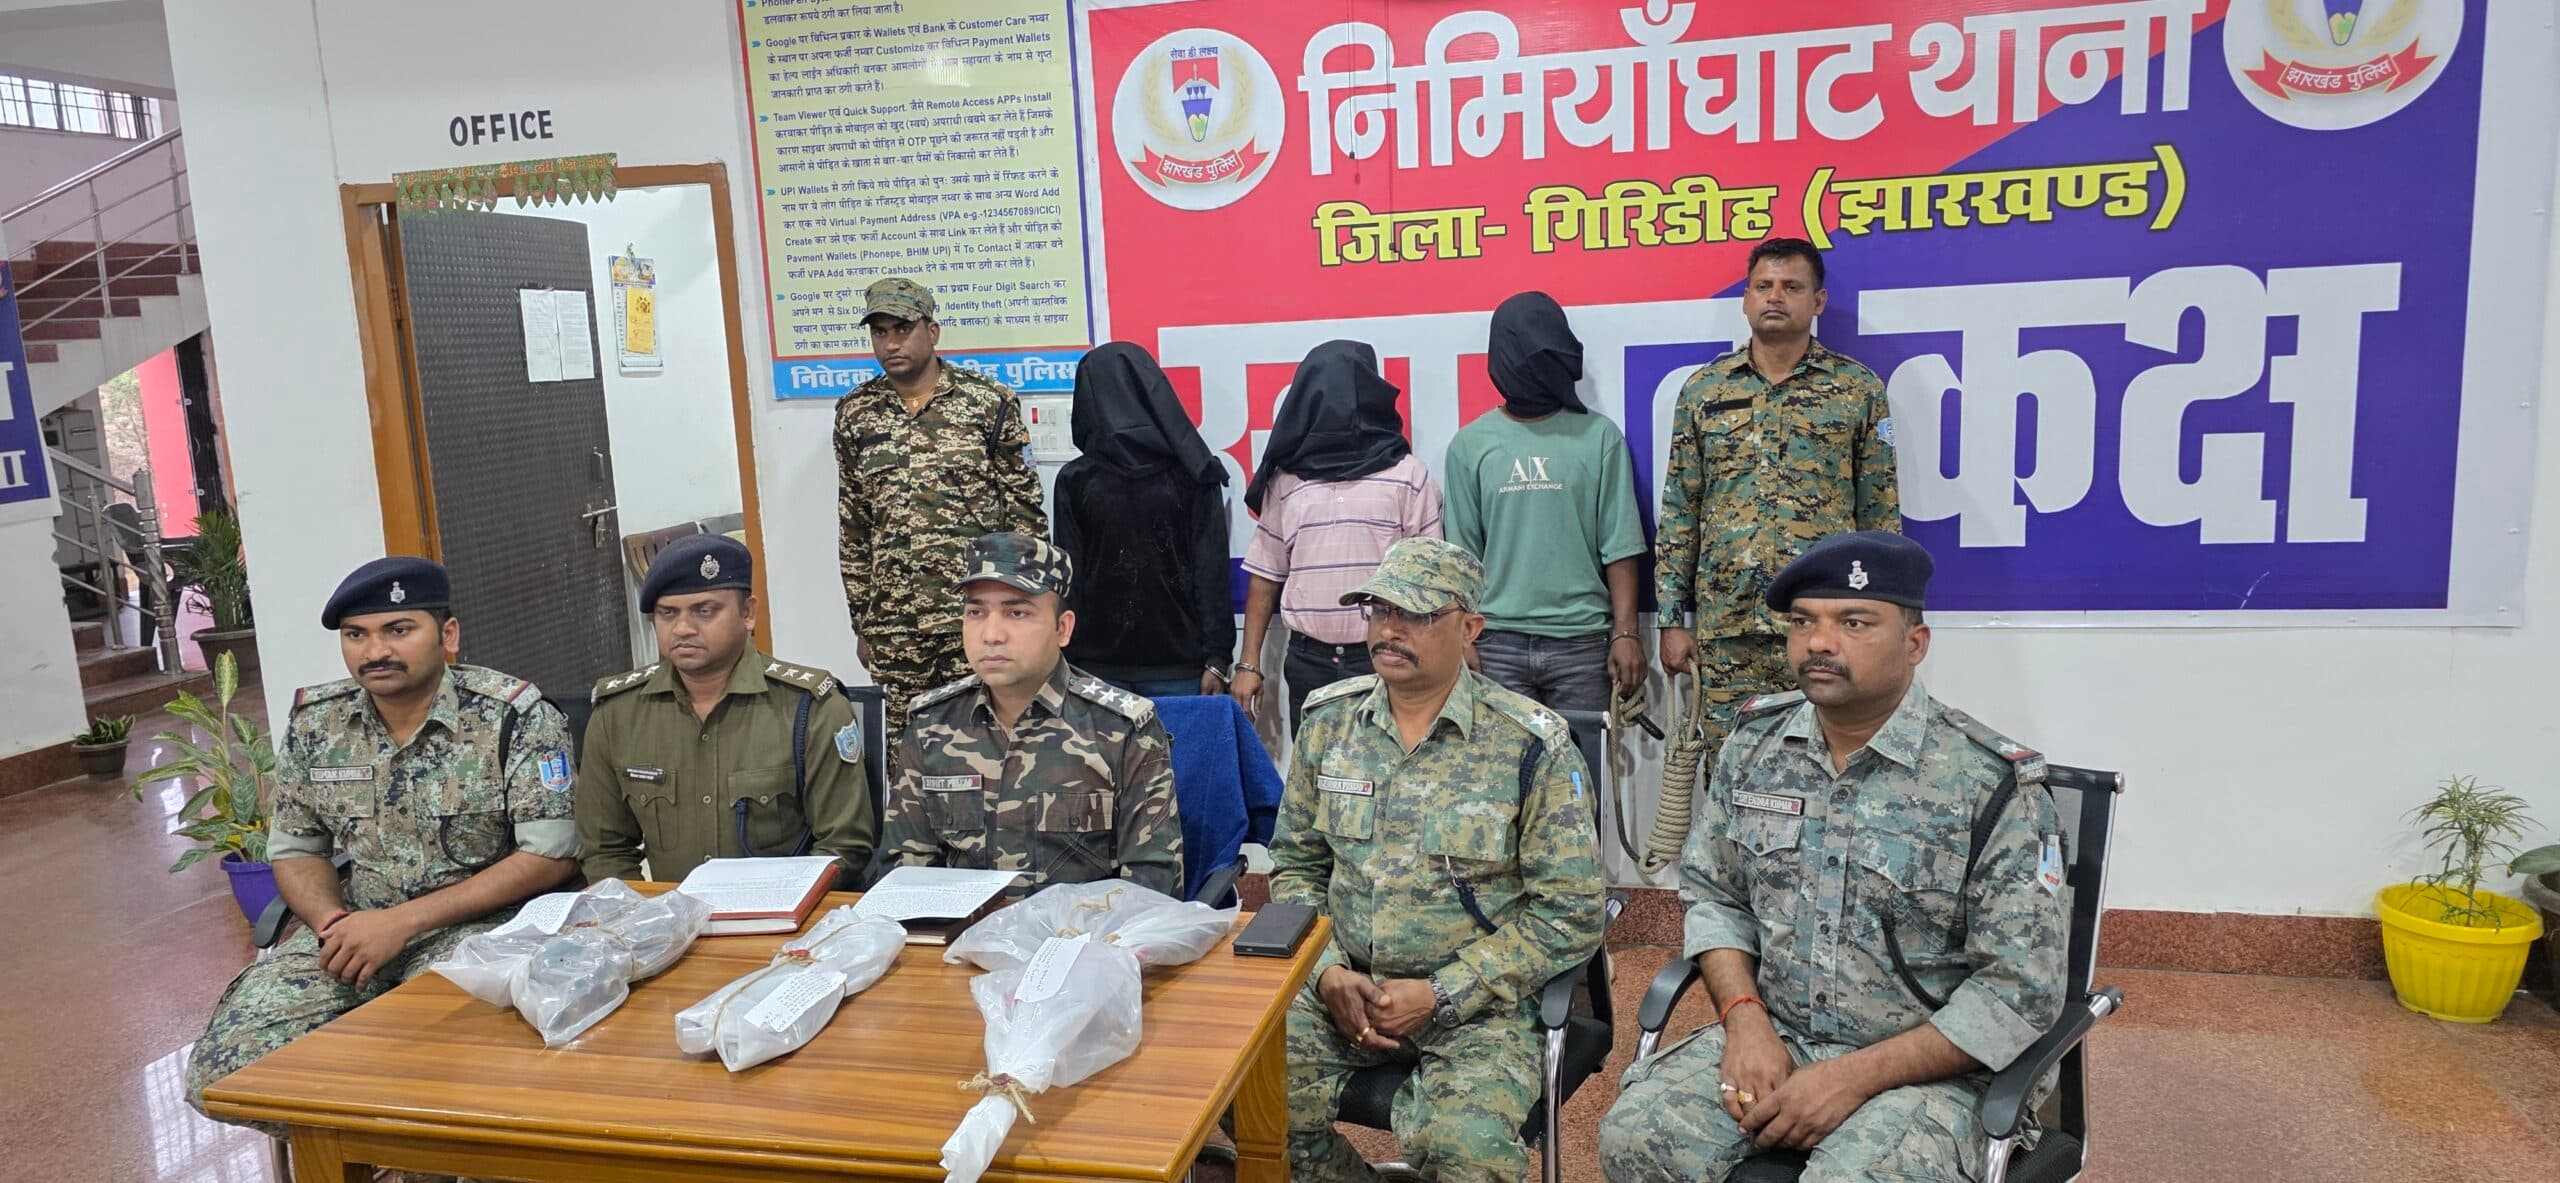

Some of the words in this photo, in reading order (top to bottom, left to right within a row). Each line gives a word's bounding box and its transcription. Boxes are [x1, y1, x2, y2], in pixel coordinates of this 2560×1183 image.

[837, 9, 849, 17] कर
[766, 37, 796, 48] Google
[798, 35, 808, 44] पर
[839, 30, 861, 41] प्रकार
[863, 26, 872, 38] के
[874, 27, 906, 38] Wallets
[907, 22, 920, 37] एवं
[923, 23, 946, 33] Bank
[947, 18, 957, 30] के
[959, 20, 1003, 30] Customer
[1005, 17, 1026, 26] Care
[767, 52, 776, 64] के
[777, 54, 797, 62] स्थान
[798, 53, 809, 61] पर
[811, 51, 832, 60] अपना
[876, 43, 924, 55] Customize
[972, 35, 1014, 48] Payment
[1016, 32, 1051, 43] Wallets
[769, 73, 780, 81] का
[826, 63, 860, 76] अधिकारी
[994, 51, 1003, 63] के
[1006, 52, 1022, 61] नाम
[1036, 50, 1052, 63] गुप्त
[1908, 0, 2207, 127] थाना
[2286, 66, 2343, 89] झारखंड
[2346, 60, 2392, 90] पुलिस
[771, 85, 804, 98] जानकारी
[824, 86, 836, 95] कर
[773, 113, 796, 122] Team
[798, 111, 827, 120] Viewer
[828, 106, 841, 119] एवं
[843, 106, 868, 116] Quick
[927, 100, 960, 110] Remote
[962, 98, 995, 107] Access
[997, 94, 1022, 104] APPs
[1024, 92, 1051, 102] Install
[449, 110, 554, 147] OFFICE
[774, 128, 807, 138] करवाकर
[834, 122, 843, 134] के
[876, 119, 888, 130] को
[933, 113, 962, 126] अपराधी
[988, 113, 1001, 122] कर
[776, 146, 799, 155] कारण
[828, 139, 857, 152] अपराधी
[908, 136, 927, 146] OTP
[1039, 125, 1054, 136] और
[778, 160, 806, 172] आसानी
[841, 157, 850, 168] के
[978, 150, 991, 158] कर
[1162, 160, 1203, 178] झारखंड
[1206, 155, 1238, 180] पुलिस
[781, 186, 796, 196] UPI
[798, 185, 829, 194] Wallets
[1050, 166, 1059, 178] के
[781, 204, 796, 212] नाम
[820, 199, 836, 210] लोग
[864, 196, 873, 207] के
[963, 190, 973, 200] के
[996, 190, 1012, 198] अन्य
[1015, 188, 1039, 198] Word
[1042, 187, 1060, 196] Add
[1312, 200, 1507, 267] जिला-
[1524, 175, 1779, 254] गिरिडीह
[1801, 144, 2187, 249] (झारखण्ड)
[783, 220, 796, 229] कर
[798, 220, 812, 231] एक
[829, 217, 857, 226] Virtual
[860, 215, 898, 226] Payment
[901, 213, 936, 222] Address
[940, 210, 961, 223] (VPA
[785, 237, 812, 246] Create
[814, 236, 827, 244] कर
[842, 234, 856, 245] एक
[881, 231, 917, 240] Account
[918, 227, 927, 238] के
[948, 228, 967, 237] Link
[968, 227, 982, 235] कर
[1008, 222, 1022, 233] और
[826, 252, 857, 261] Wallets
[906, 247, 930, 256] BHIM
[933, 246, 951, 256] UPI)
[963, 244, 974, 253] To
[978, 243, 1012, 252] Contact
[808, 269, 826, 278] VPA
[827, 269, 844, 278] Add
[845, 267, 879, 276] करवाकर
[881, 264, 924, 274] Cashback
[939, 262, 948, 271] के
[950, 262, 964, 271] नाम
[966, 261, 976, 270] पर
[994, 260, 1008, 268] कर
[790, 292, 820, 302] Google
[823, 291, 833, 299] पर
[936, 285, 948, 293] का
[972, 283, 992, 292] Four
[996, 282, 1016, 293] Digit
[1020, 280, 1050, 290] Search
[1053, 280, 1066, 288] कर
[792, 306, 810, 317] अपने
[837, 306, 850, 315] Six
[982, 300, 1002, 309] theft
[993, 316, 1002, 324] के
[790, 365, 874, 389] निवेदक
[1005, 356, 1077, 388] पुलिस
[1858, 262, 2403, 548] कक्ष
